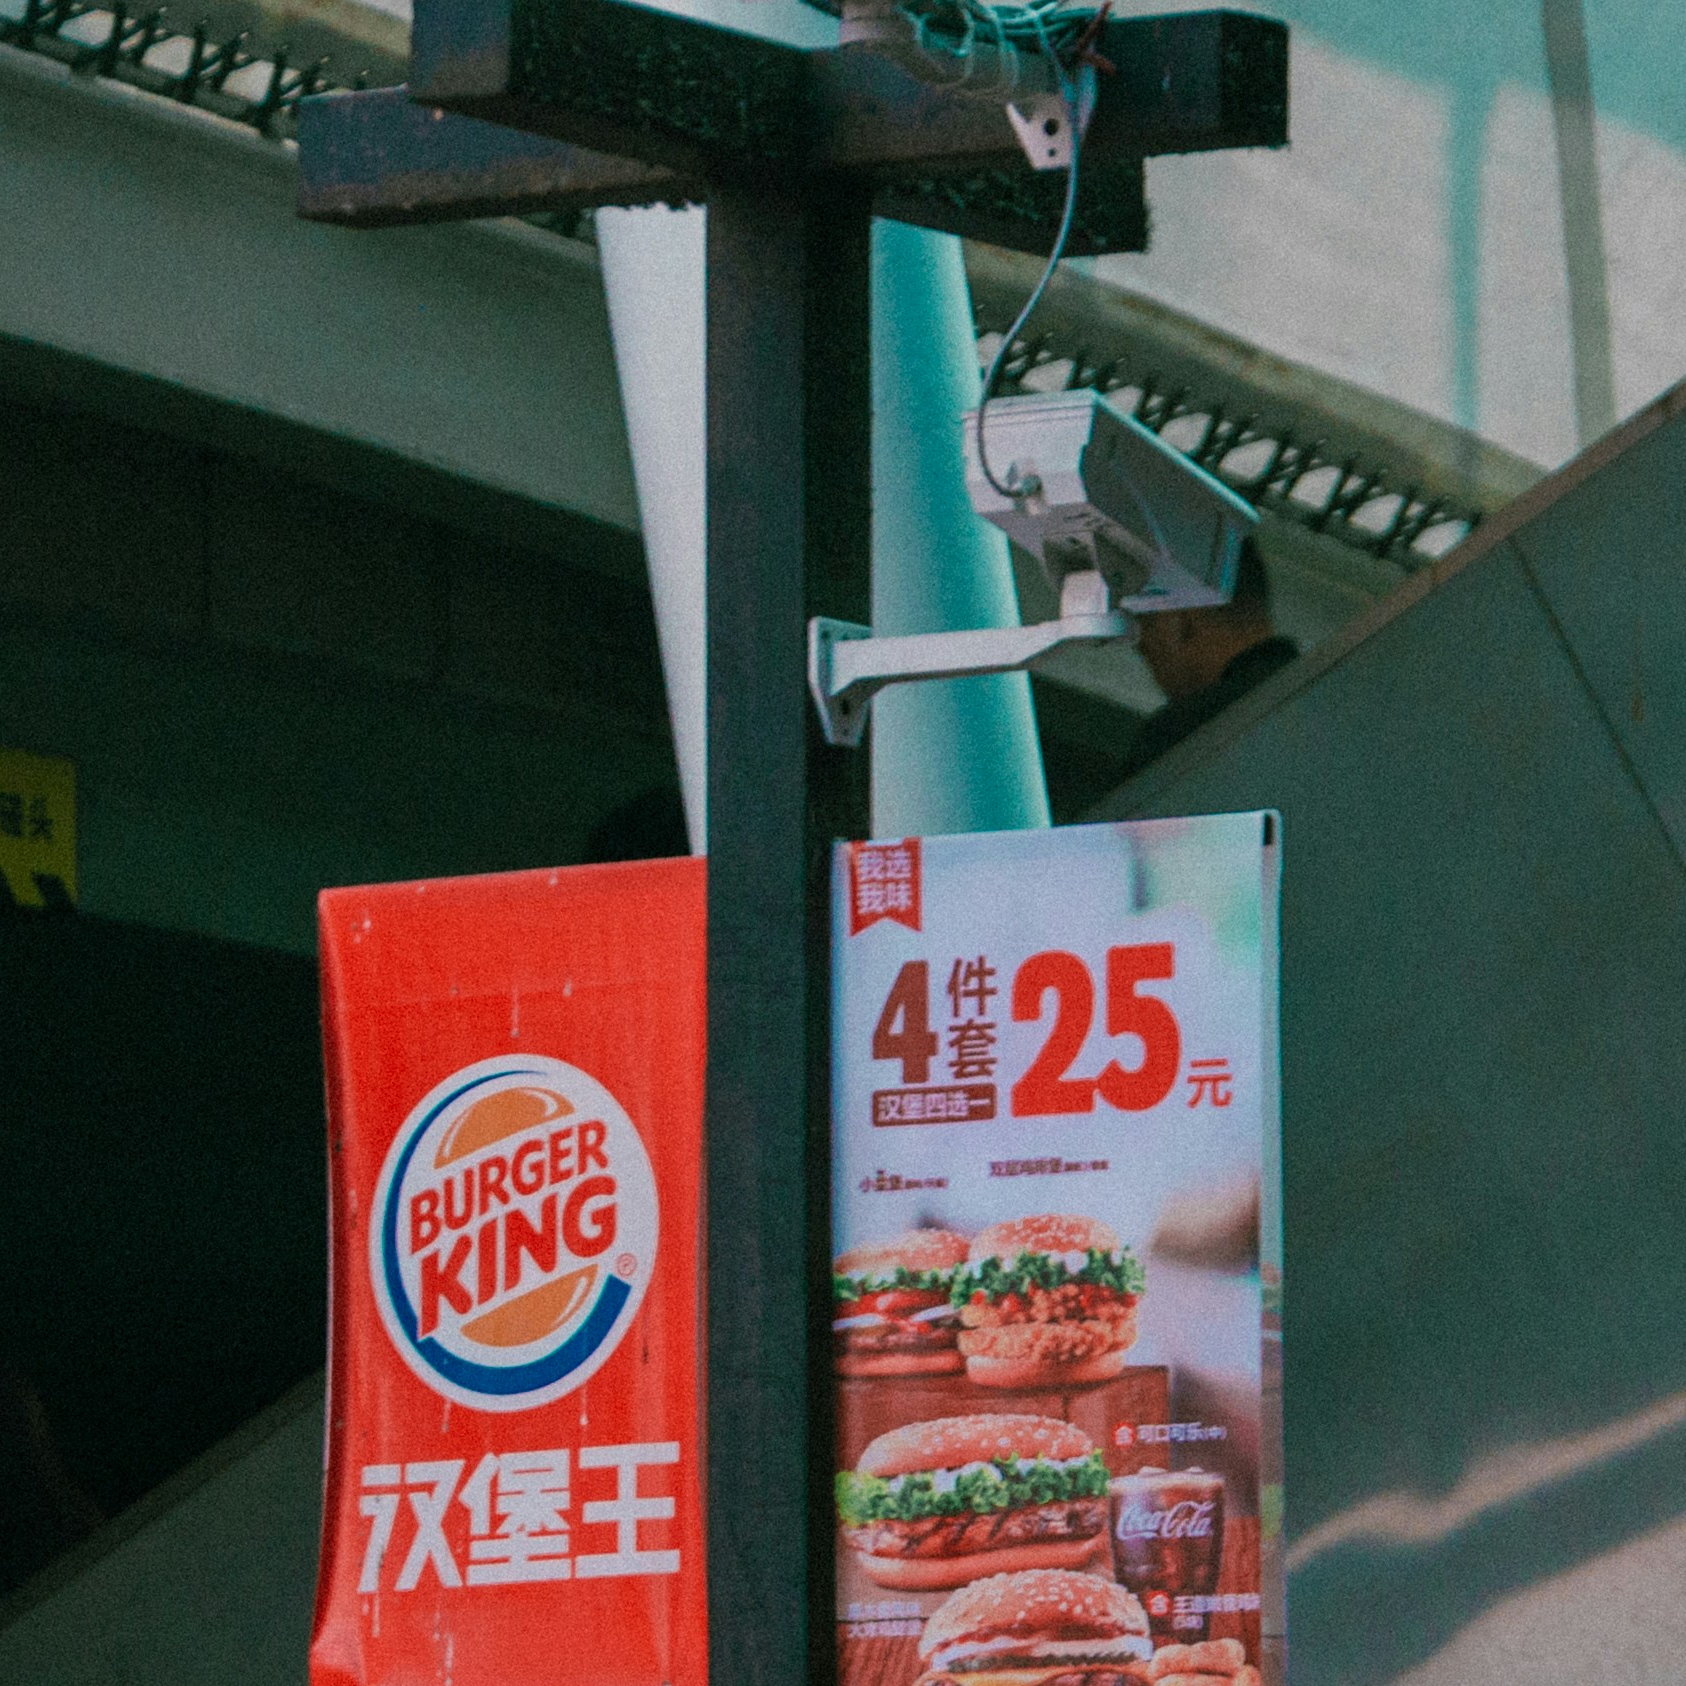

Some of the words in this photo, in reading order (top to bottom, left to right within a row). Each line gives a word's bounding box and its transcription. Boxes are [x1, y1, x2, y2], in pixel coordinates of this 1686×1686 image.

[408, 1119, 610, 1256] BURGER
[417, 1174, 618, 1341] KING
[358, 1441, 681, 1596] 汉堡王
